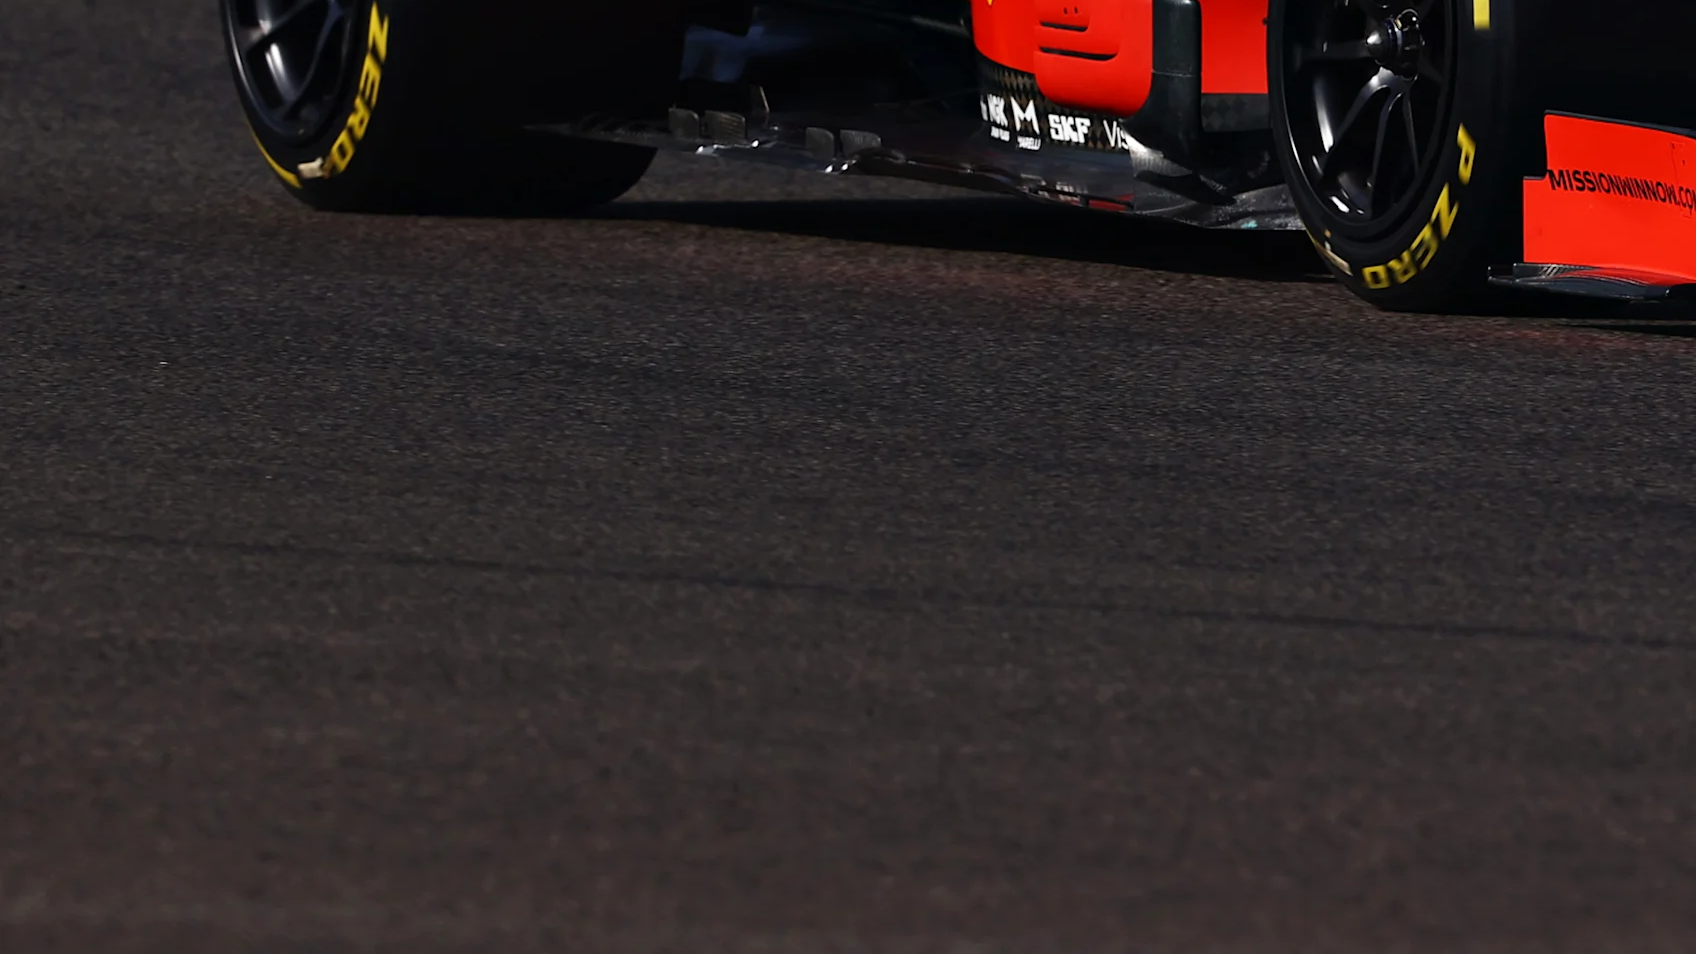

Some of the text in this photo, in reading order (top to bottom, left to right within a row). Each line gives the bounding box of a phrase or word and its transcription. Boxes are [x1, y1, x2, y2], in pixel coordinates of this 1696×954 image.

[328, 2, 389, 175] ZERO
[1048, 113, 1091, 144] SKF
[1360, 123, 1476, 289] P ZERO
